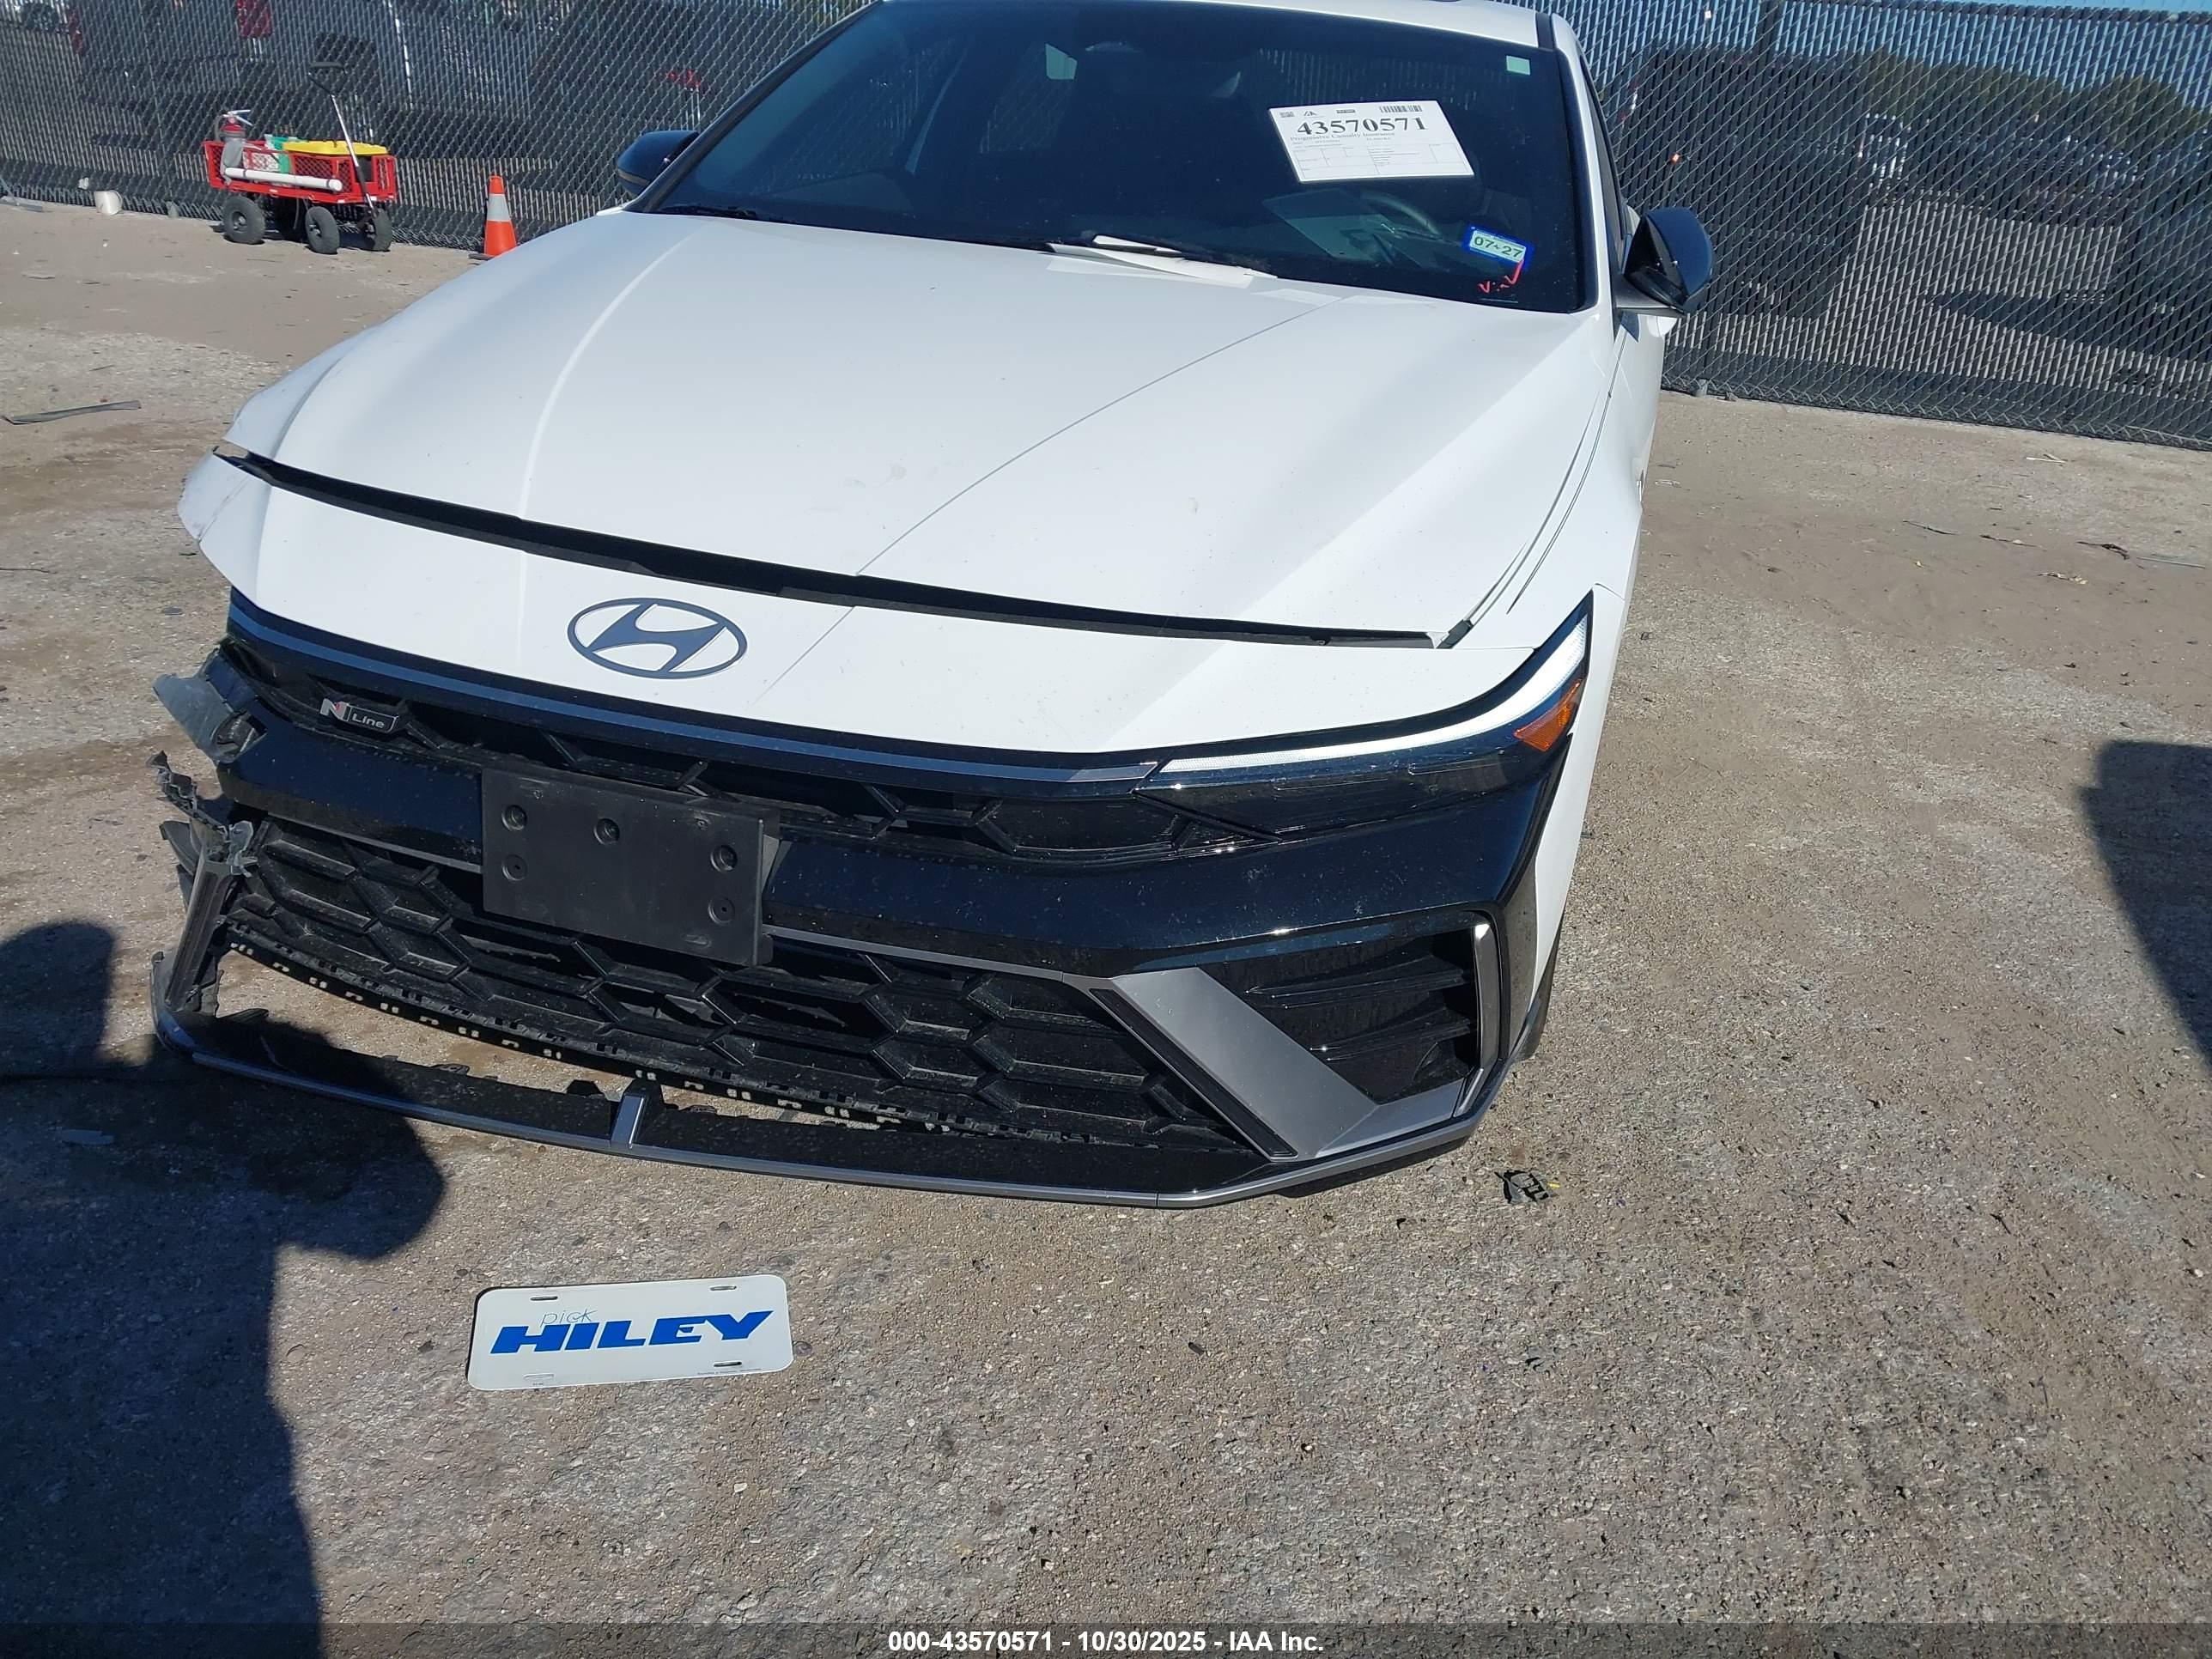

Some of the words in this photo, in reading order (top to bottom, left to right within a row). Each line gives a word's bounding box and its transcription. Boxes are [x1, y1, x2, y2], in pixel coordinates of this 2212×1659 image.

[1297, 117, 1428, 136] 43570571
[351, 713, 385, 729] Line
[489, 1310, 775, 1354] HILEY
